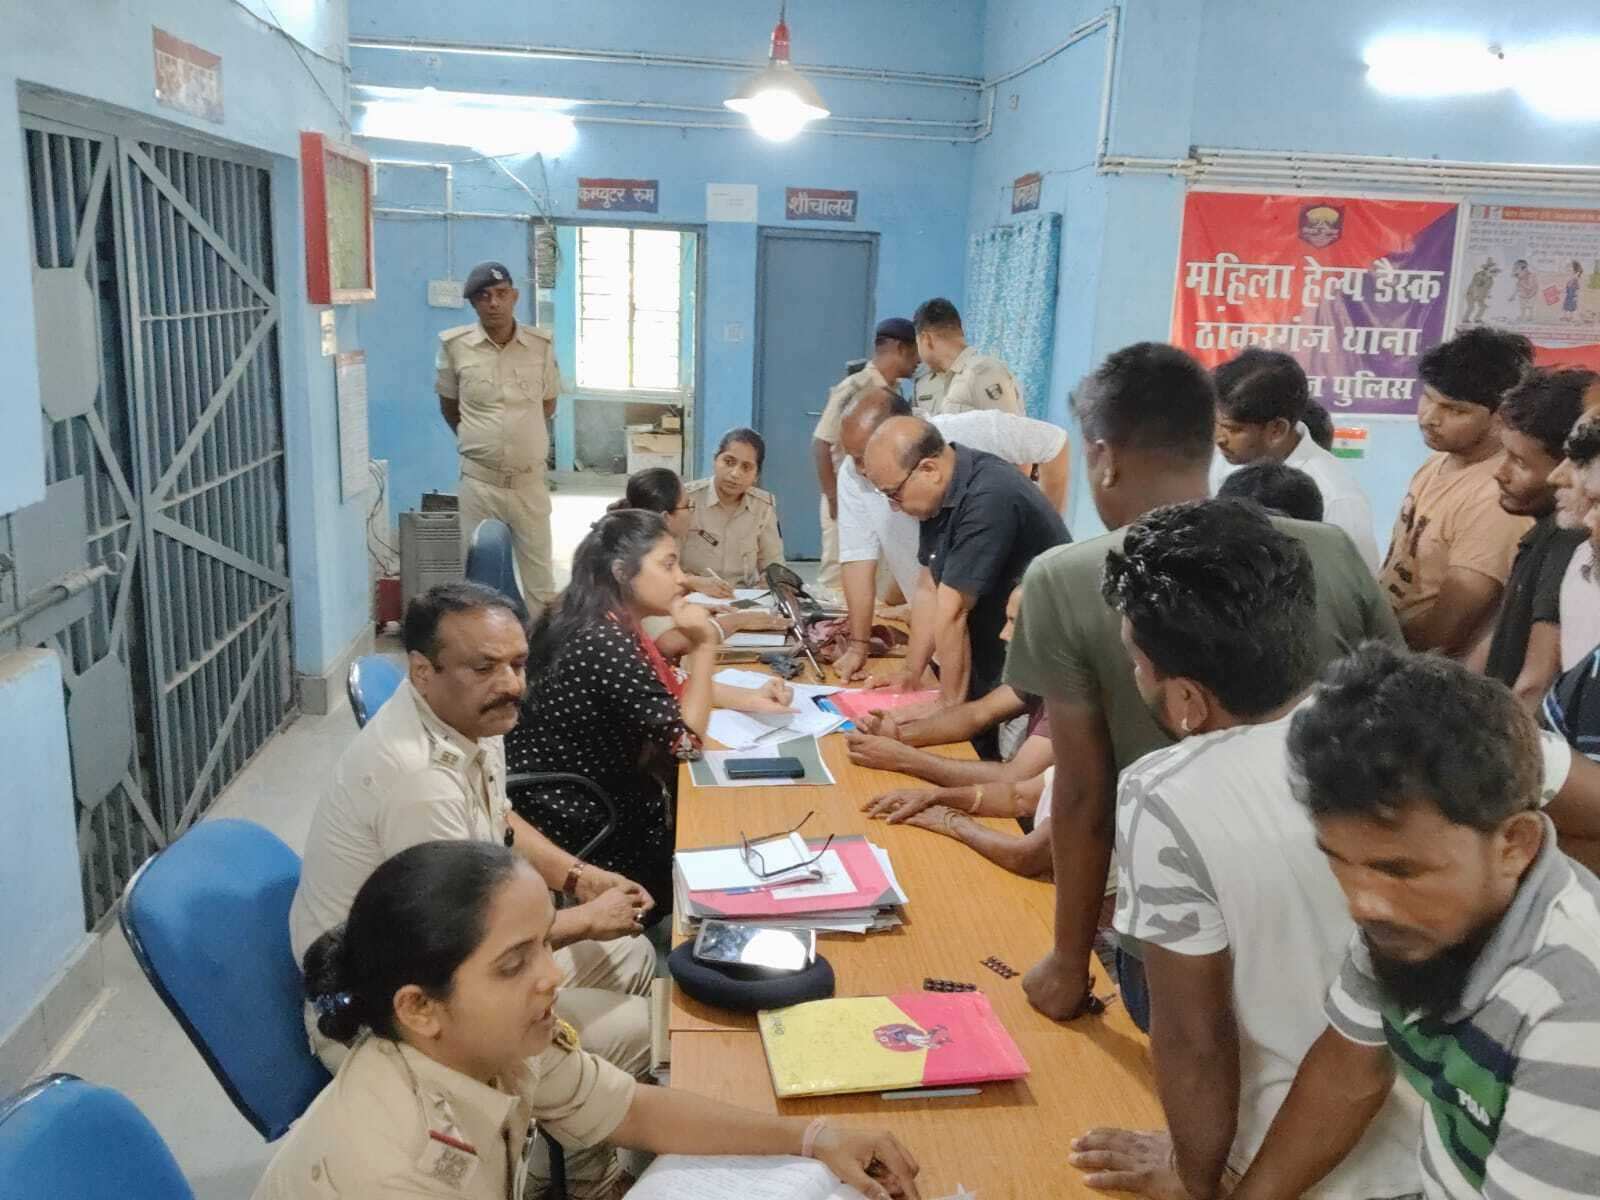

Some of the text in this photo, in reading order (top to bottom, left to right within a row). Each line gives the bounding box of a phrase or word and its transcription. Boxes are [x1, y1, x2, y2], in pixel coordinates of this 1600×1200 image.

[1185, 252, 1296, 305] महिला
[1302, 255, 1368, 308] हेल्प
[1342, 325, 1423, 356] थाना
[1333, 369, 1417, 407] पुलिस
